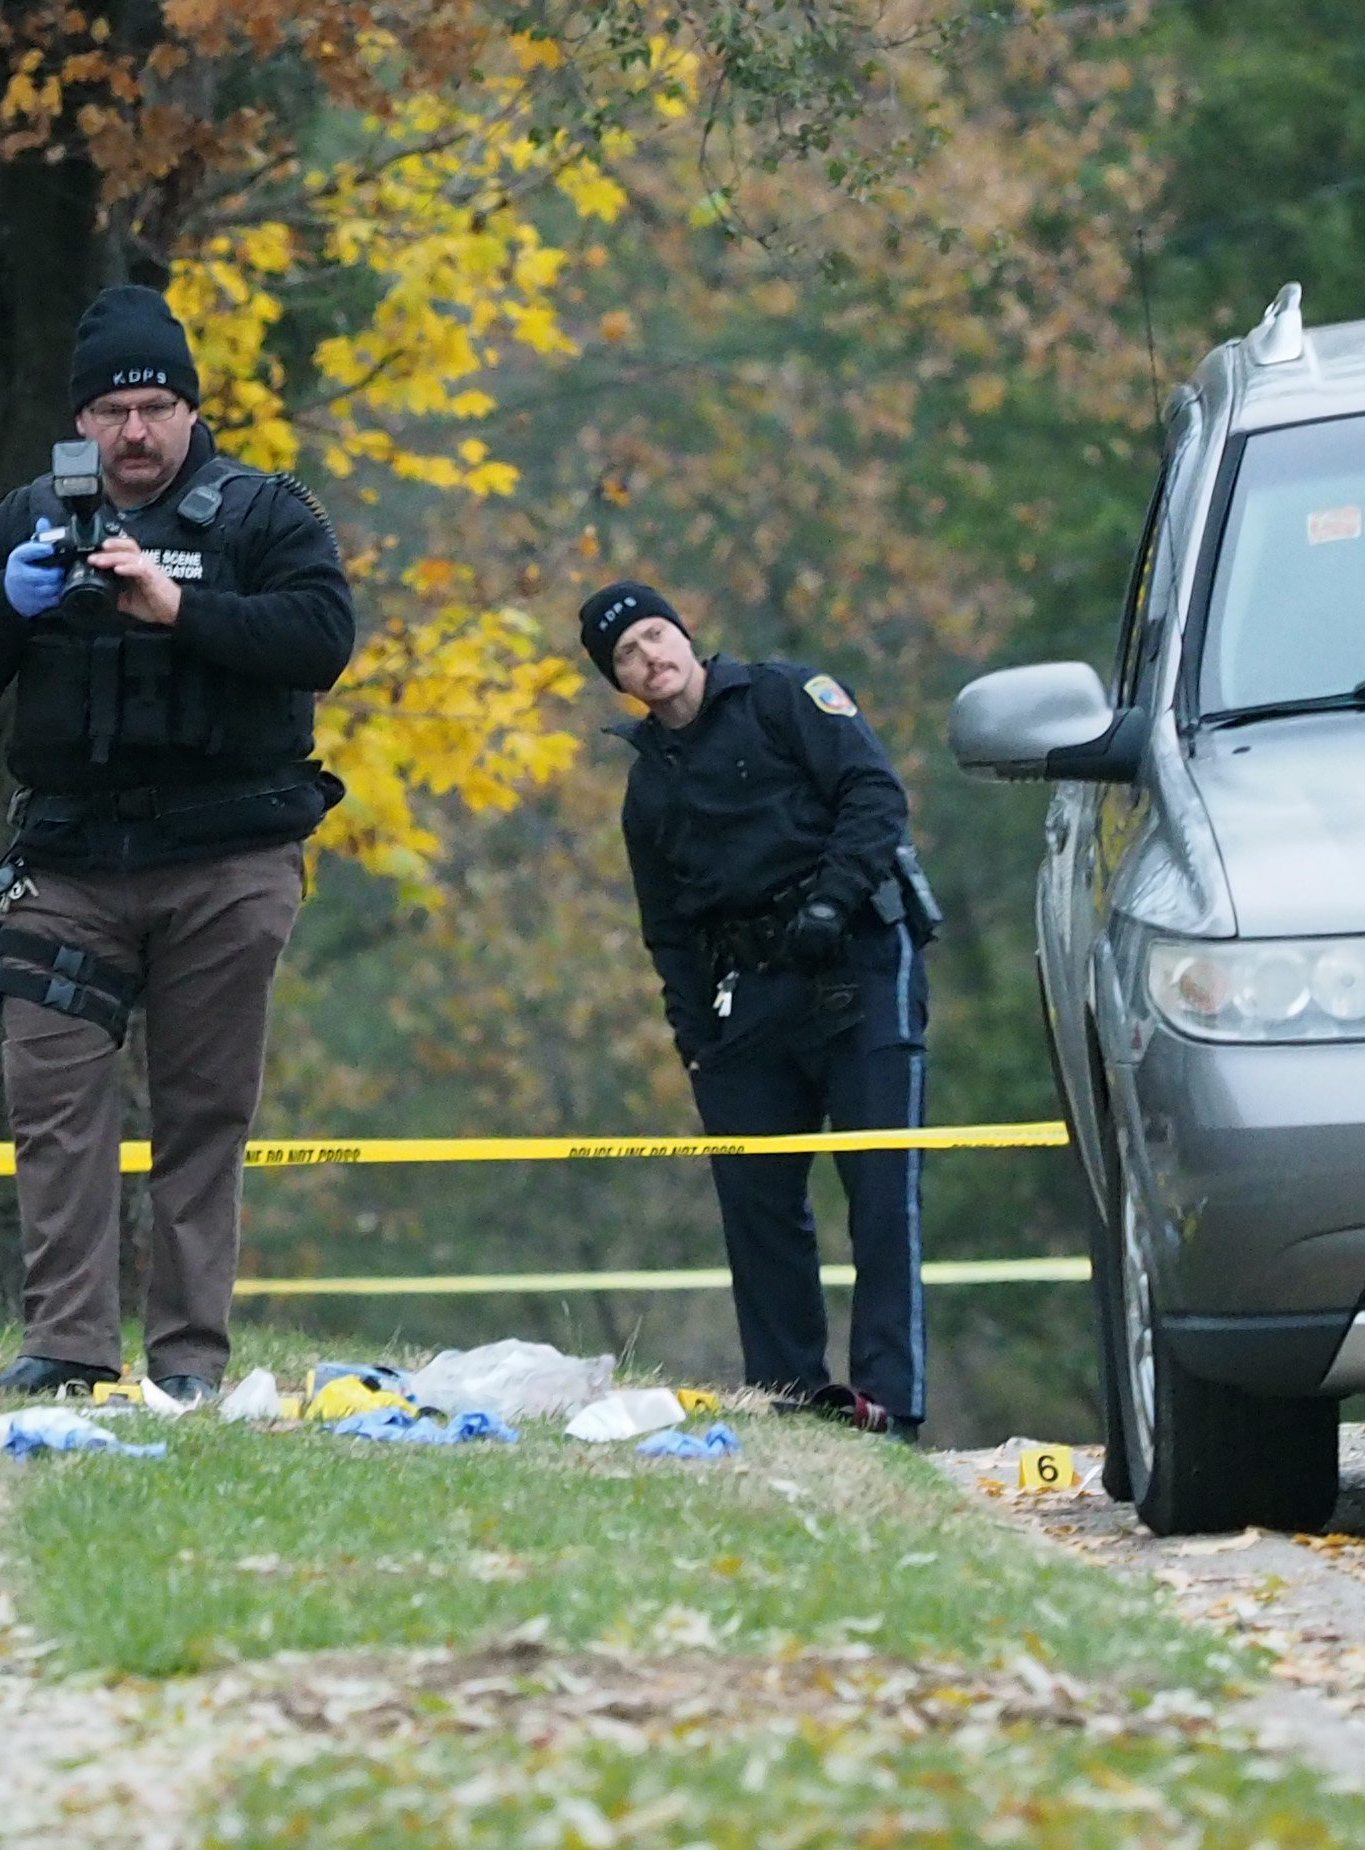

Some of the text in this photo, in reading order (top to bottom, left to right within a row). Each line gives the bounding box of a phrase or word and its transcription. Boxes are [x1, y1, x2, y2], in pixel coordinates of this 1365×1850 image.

[113, 367, 167, 385] KDPS
[162, 549, 202, 566] SCENE
[1037, 1455, 1058, 1482] 6
